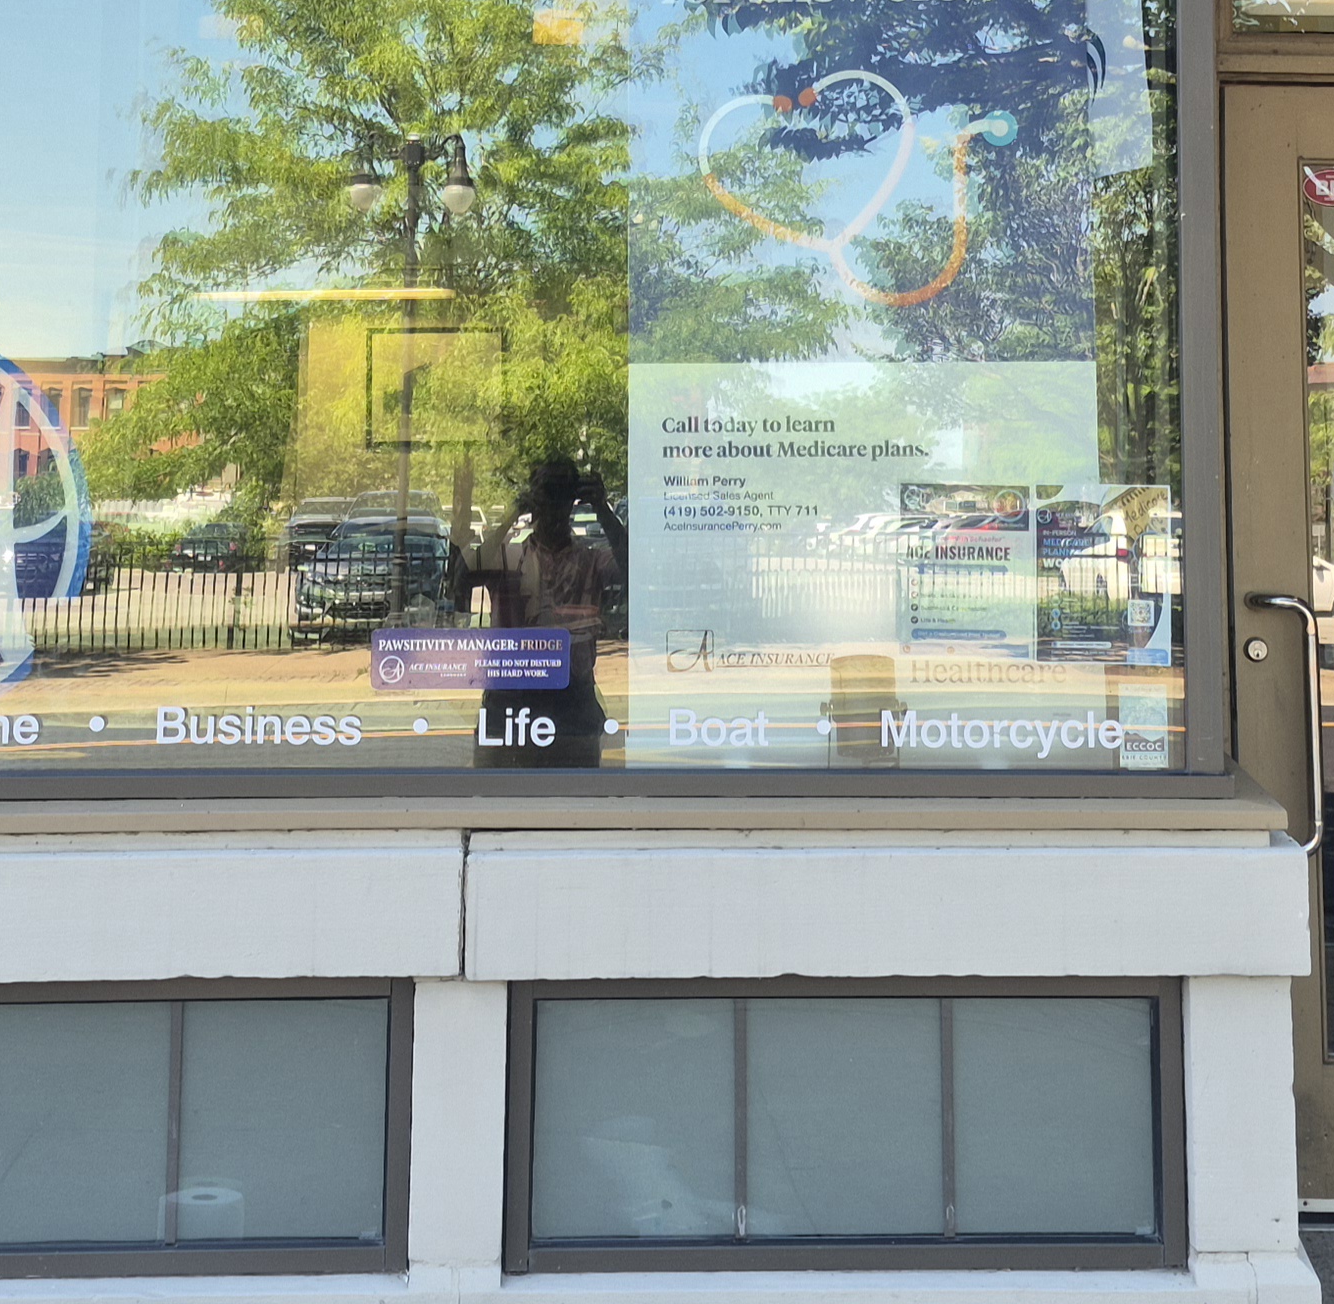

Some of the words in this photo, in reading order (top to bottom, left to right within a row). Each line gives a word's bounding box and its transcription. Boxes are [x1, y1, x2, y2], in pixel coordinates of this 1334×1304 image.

[661, 416, 699, 434] Call
[704, 416, 757, 437] today
[762, 418, 782, 433] to
[786, 415, 836, 433] learn
[662, 444, 713, 459] more
[717, 440, 775, 459] about
[777, 440, 867, 458] Medicare
[871, 440, 930, 462] plans.
[664, 476, 709, 487] William
[713, 476, 746, 489] Perry
[664, 491, 710, 501] Licensed
[713, 491, 741, 501] Sales
[744, 491, 774, 502] Agent
[663, 505, 697, 519] (419)
[700, 505, 763, 518] 502-9150,
[767, 506, 791, 516] TTY
[796, 505, 818, 516] 711
[664, 521, 782, 533] AceInsurancePerry.com
[935, 546, 1011, 562] INSURANCE
[378, 639, 455, 652] PAWSITIVITY
[457, 639, 519, 652] MANAGER:
[520, 639, 563, 651] FRIDGE
[474, 659, 501, 667] PLEASE
[502, 659, 513, 667] DO
[514, 659, 529, 667] NOT
[530, 659, 562, 668] DISTURB
[717, 653, 747, 666] ACE
[750, 652, 835, 666] INSURANCE
[501, 670, 523, 678] HARD
[524, 670, 549, 678] WORK.
[911, 660, 1067, 685] Healthcare
[156, 706, 362, 747] Business
[478, 707, 556, 747] Life
[669, 708, 769, 748] Boat
[880, 709, 1124, 760] Motorcycle
[1126, 742, 1163, 752] ECCOC
